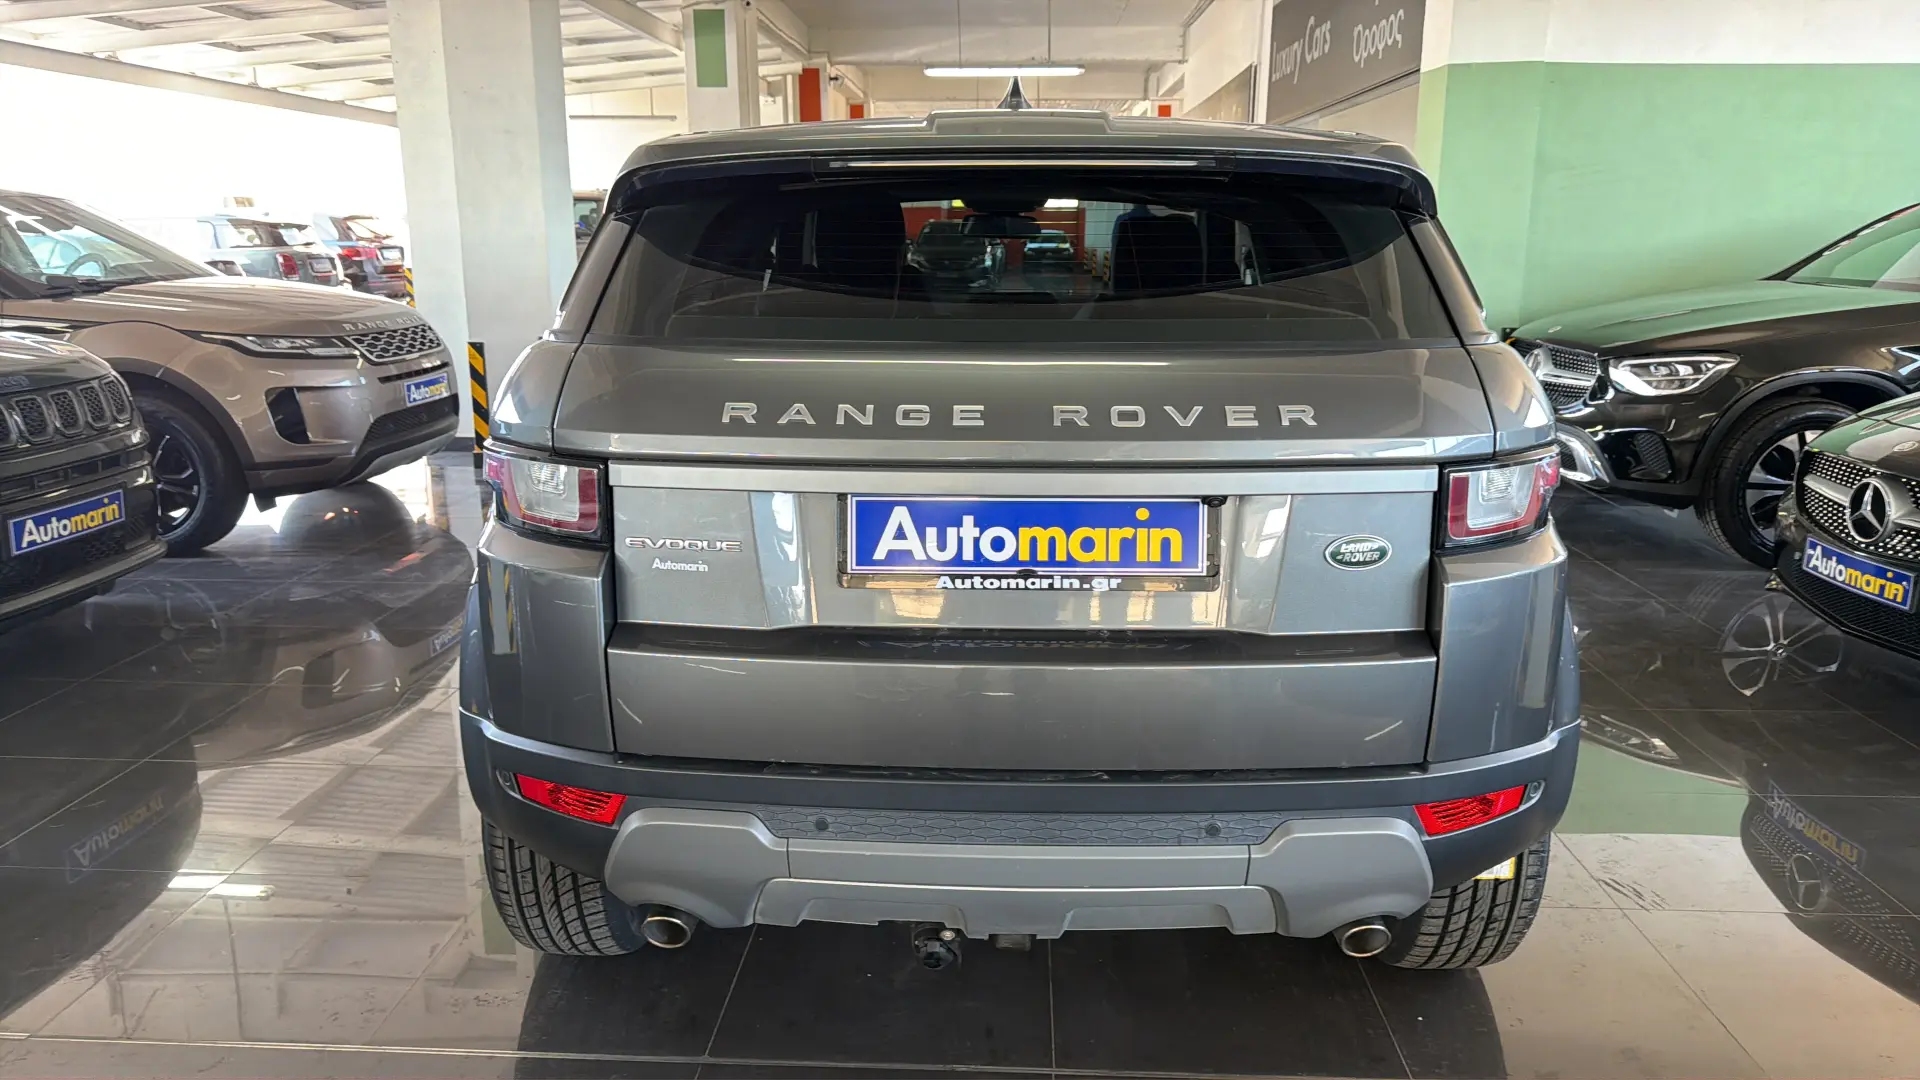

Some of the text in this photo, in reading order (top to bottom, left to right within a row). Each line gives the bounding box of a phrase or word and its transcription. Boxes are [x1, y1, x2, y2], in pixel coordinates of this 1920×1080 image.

[1271, 15, 1331, 85] Luxury Cars
[721, 402, 1318, 428] RANGE ROVER
[20, 498, 119, 549] Automarin
[872, 505, 1183, 563] Automarin
[624, 536, 743, 552] EVOQUE
[1340, 542, 1371, 553] LAND
[652, 557, 708, 572] Automarin
[1342, 551, 1380, 562] ROVER
[935, 575, 1122, 592] Automarin.gr
[1808, 545, 1905, 602] Automarin
